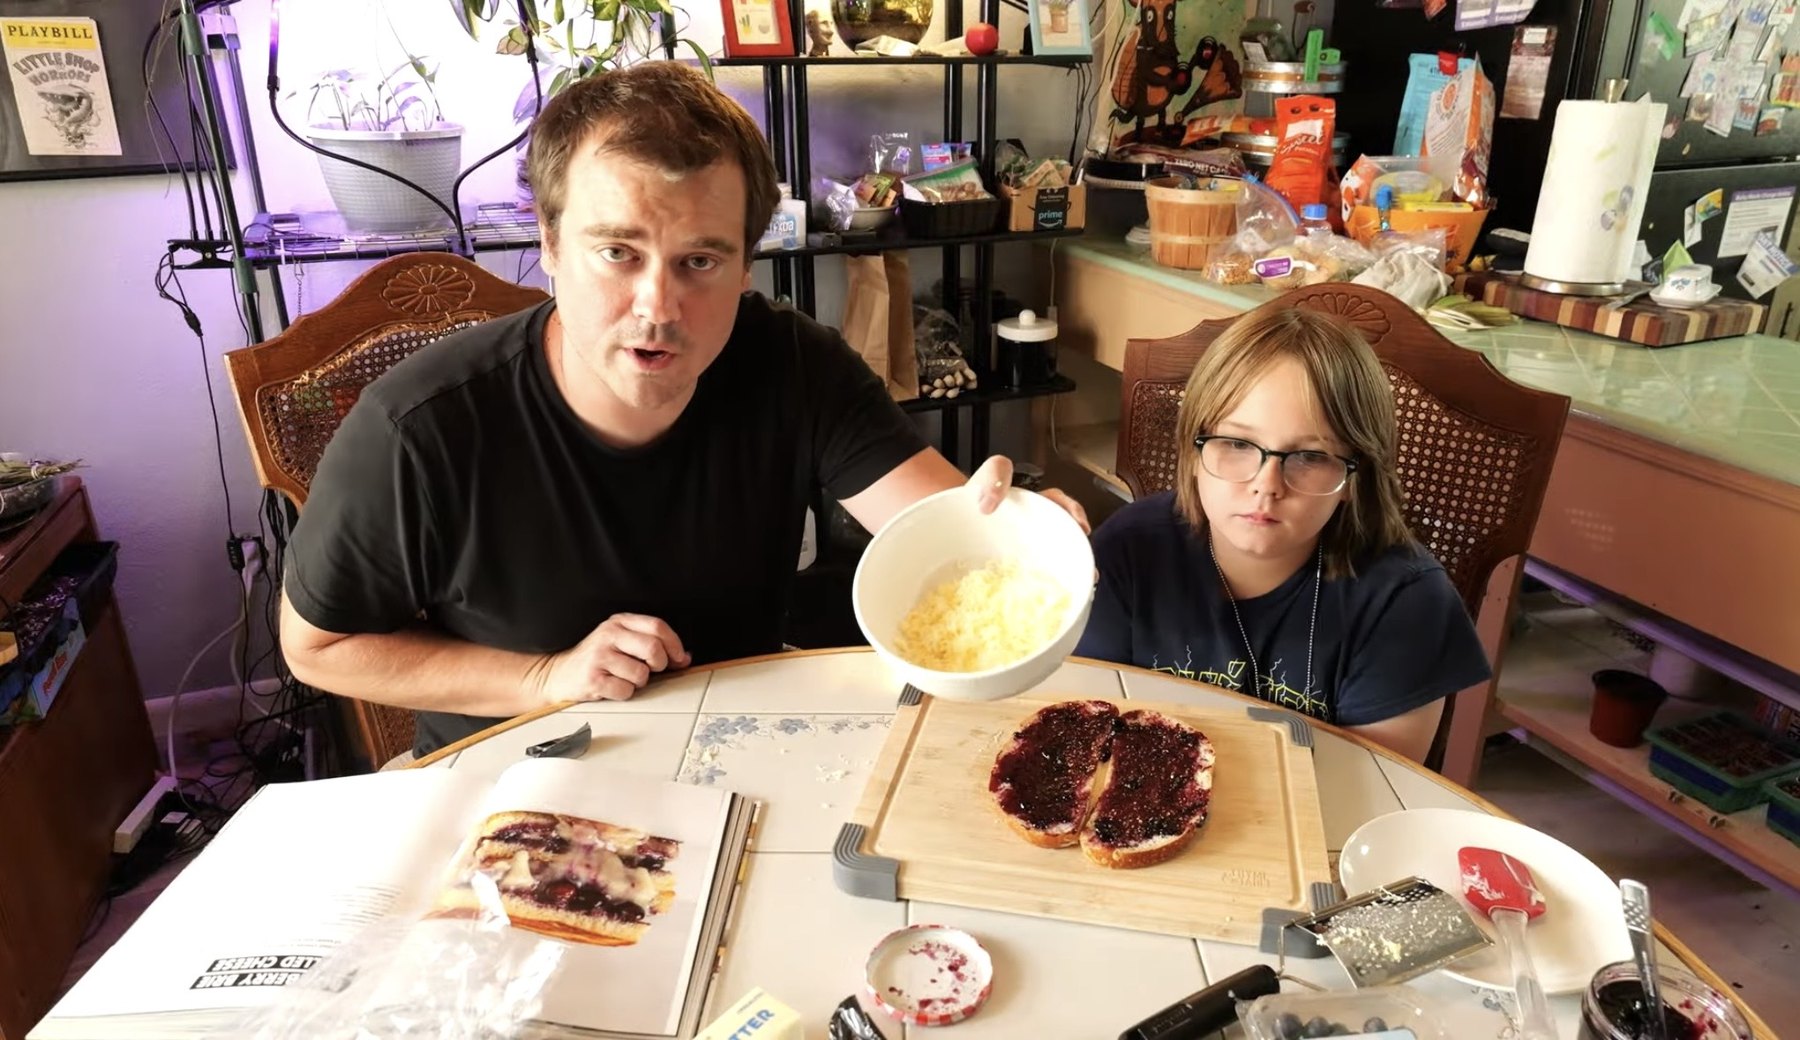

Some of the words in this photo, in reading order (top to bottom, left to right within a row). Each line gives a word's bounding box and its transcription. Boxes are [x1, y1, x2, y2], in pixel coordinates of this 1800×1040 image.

[7, 25, 92, 39] PLAYBILL
[13, 52, 62, 75] LITTLE
[65, 52, 100, 73] SHOP
[28, 69, 91, 86] HORRORS
[1038, 210, 1063, 221] prime
[212, 956, 279, 971] CHEESE
[195, 974, 239, 988] BRIE
[237, 972, 301, 986] BERRY
[728, 1009, 775, 1040] TTER
